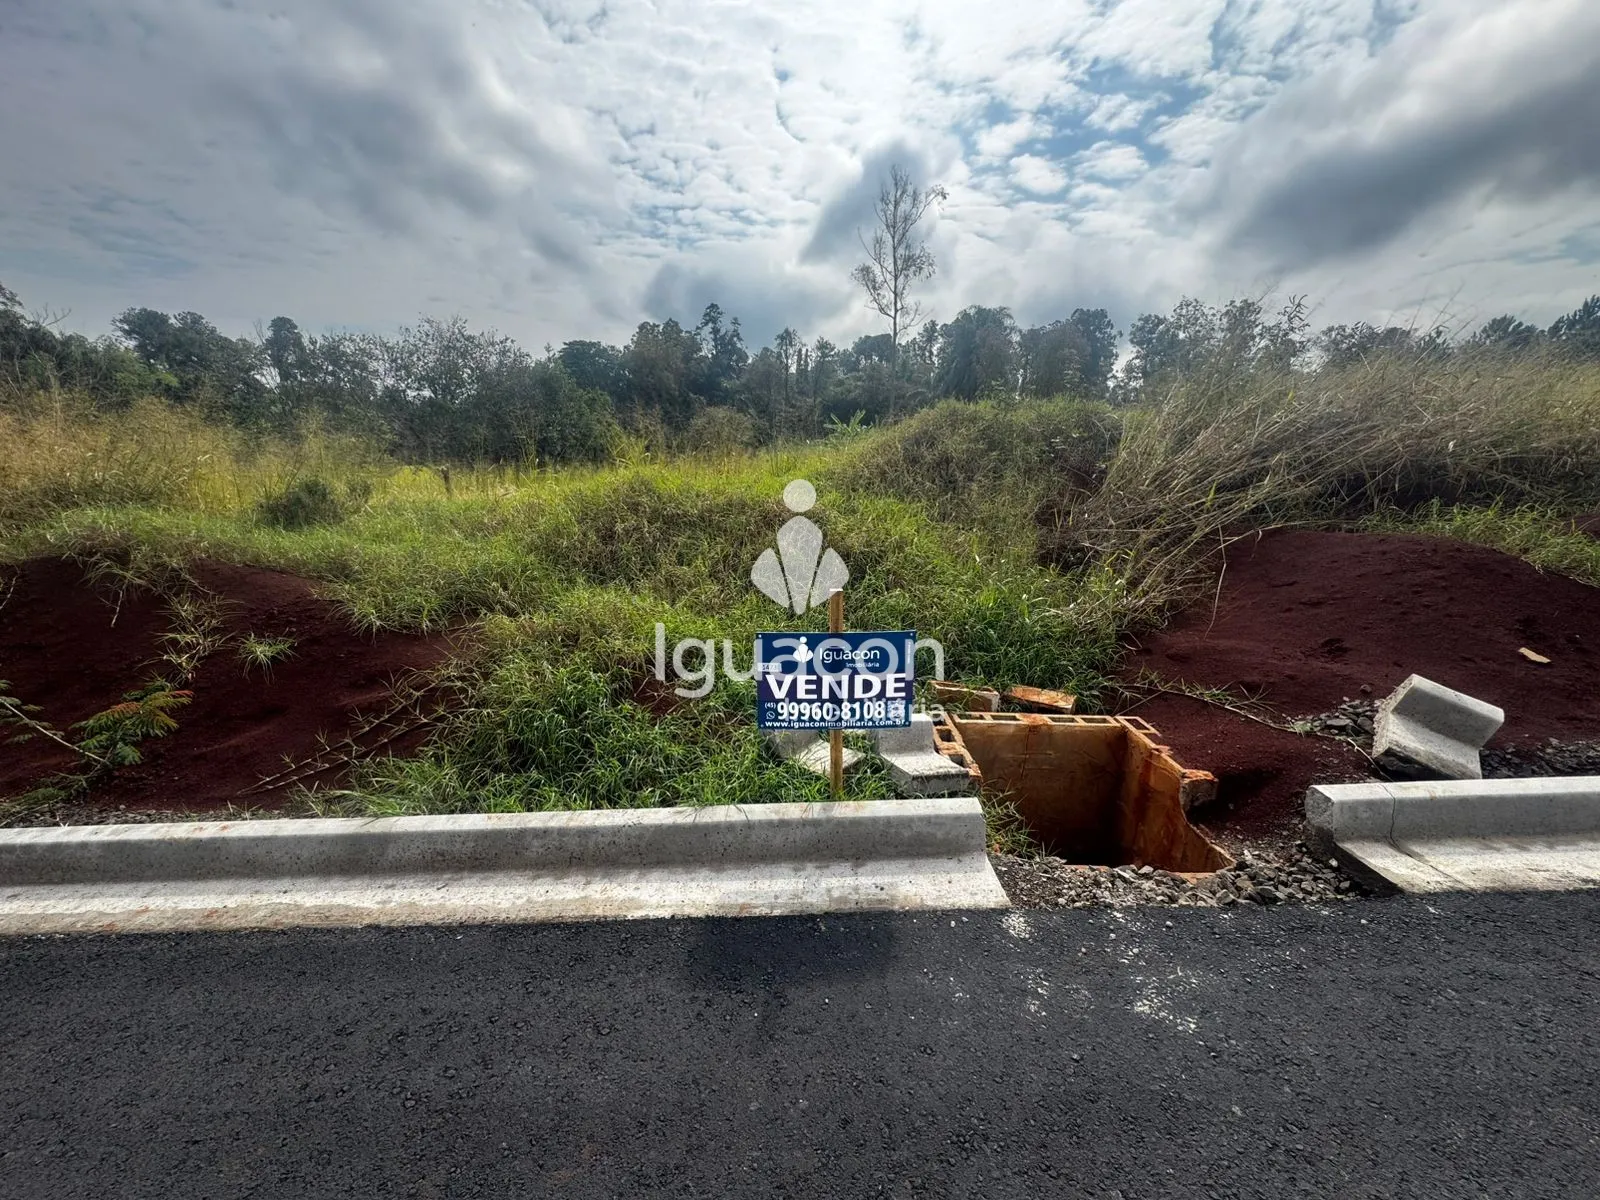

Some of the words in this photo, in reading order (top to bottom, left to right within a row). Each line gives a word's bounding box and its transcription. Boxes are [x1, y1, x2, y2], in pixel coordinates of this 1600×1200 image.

[820, 647, 880, 663] Iguacon
[765, 674, 906, 700] VENDE
[777, 701, 885, 720] 99960-8108
[765, 718, 905, 729] www.iguaconimobiliaria.com.br
